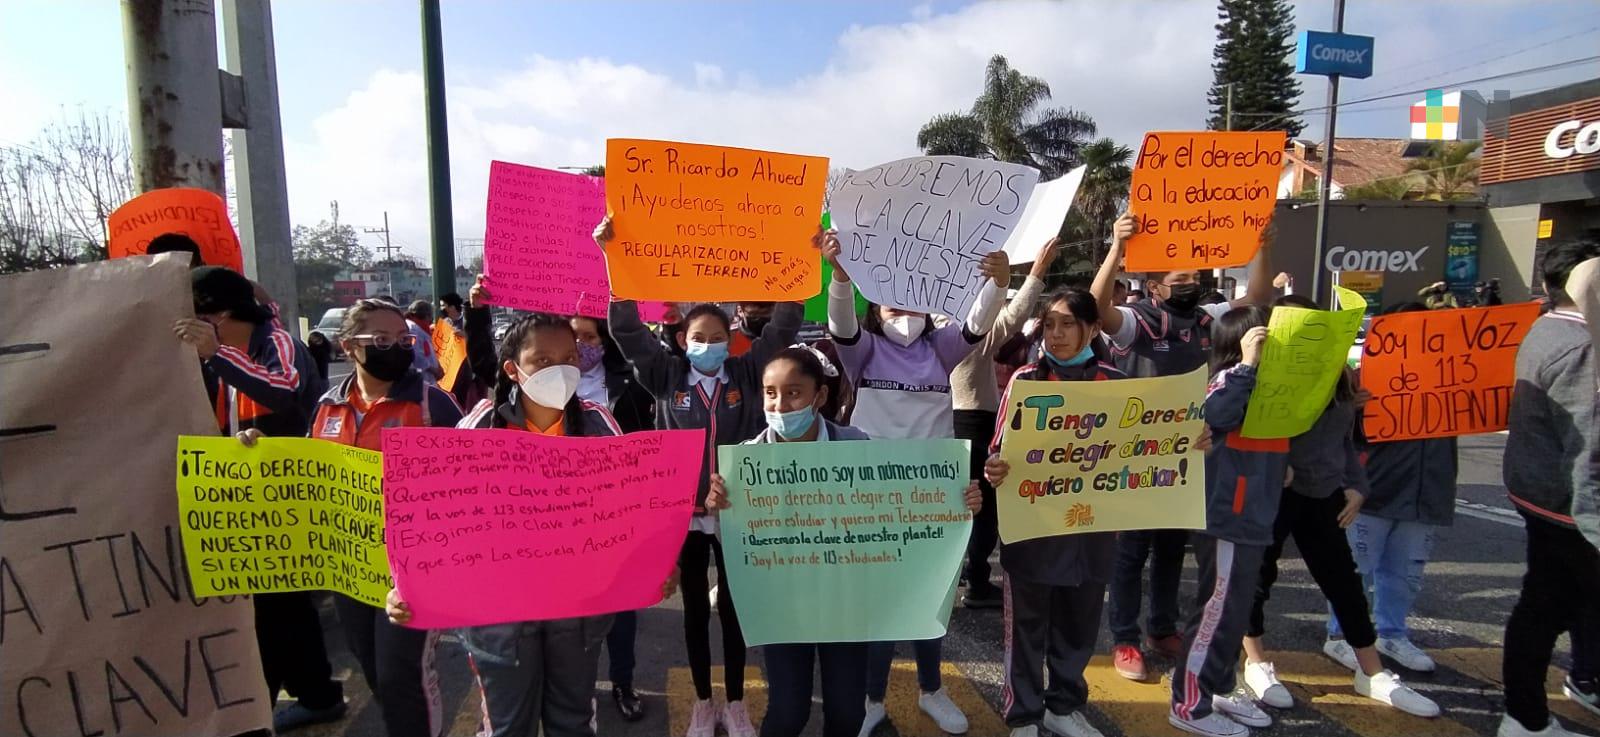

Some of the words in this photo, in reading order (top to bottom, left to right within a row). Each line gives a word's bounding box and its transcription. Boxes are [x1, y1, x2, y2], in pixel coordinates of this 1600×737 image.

[1311, 43, 1368, 64] Comex
[1175, 138, 1193, 168] el
[1201, 138, 1282, 168] derecho
[1544, 120, 1600, 159] Co
[624, 147, 653, 174] Sr.
[665, 148, 739, 178] Ricardo
[752, 157, 807, 186] Ahued
[620, 183, 724, 217] ¡Ayudenos
[738, 193, 782, 215] ahora
[794, 204, 805, 217] a
[1137, 183, 1152, 202] a
[1163, 178, 1177, 204] la
[1185, 178, 1269, 204] educación
[114, 206, 221, 238] ESTUDIANDO
[676, 215, 765, 241] nosotros!
[855, 194, 892, 231] LA
[901, 202, 1006, 257] CLAVE
[1169, 210, 1235, 232] nuestros
[621, 241, 749, 261] REGULARIZACION
[762, 251, 784, 265] DE
[850, 232, 878, 264] DE
[885, 237, 985, 296] NUESTR
[1166, 243, 1177, 258] e
[1191, 239, 1230, 263] hijas!
[1325, 246, 1429, 272] Comex
[656, 263, 680, 277] EL
[693, 263, 759, 278] TERRENO
[1365, 318, 1407, 359] Soy
[1422, 319, 1445, 353] la
[1389, 363, 1419, 391] de
[1434, 354, 1478, 389] 113
[1010, 395, 1107, 439] ¡Tengo
[341, 448, 379, 464] ARTICULO
[386, 453, 437, 469] ¡Tengo
[446, 451, 494, 464] derecho
[416, 435, 474, 448] existo
[482, 439, 505, 447] no
[543, 447, 560, 457] un
[1026, 449, 1044, 465] a
[1049, 439, 1116, 472] elegir
[1119, 433, 1190, 459] donde
[181, 449, 252, 480] ¡TENGO
[260, 459, 337, 481] DERECHO
[340, 467, 349, 486] A
[351, 469, 384, 496] ELEGI
[453, 467, 462, 477] y
[514, 464, 535, 475] mi
[739, 456, 762, 486] ¡Sí
[766, 459, 807, 485] existo
[811, 466, 828, 483] no
[832, 466, 854, 488] soy
[859, 466, 876, 481] un
[877, 460, 928, 481] número
[930, 460, 960, 480] más!
[1018, 475, 1084, 504] quiero
[1092, 458, 1188, 491] estudiar!
[194, 485, 257, 502] DONDE
[263, 485, 326, 502] QUIERO
[329, 486, 382, 517] ESTUDIA
[386, 486, 478, 505] ¡Queremos
[486, 483, 501, 495] la
[554, 485, 571, 496] de
[426, 508, 441, 521] la
[472, 505, 486, 515] de
[494, 504, 515, 515] 113
[519, 496, 594, 516] estudiantes!
[744, 488, 779, 514] Tengo
[785, 488, 833, 506] derecho
[837, 493, 847, 505] a
[850, 488, 884, 510] elegir
[888, 489, 903, 505] en
[187, 508, 300, 530] QUEREMOS
[310, 509, 329, 526] LA
[333, 512, 377, 542] CLAVE
[392, 520, 493, 549] ¡Exigimos
[501, 519, 517, 529] la
[572, 517, 585, 527] de
[747, 518, 781, 534] quiero
[785, 511, 826, 528] estudiar
[831, 516, 838, 529] y
[841, 515, 875, 532] quiero
[879, 512, 893, 523] mi
[814, 531, 841, 544] clave
[843, 530, 856, 543] de
[857, 526, 899, 543] nuestro
[903, 524, 944, 545] plantel!
[200, 534, 292, 553] NUESTRO
[308, 531, 372, 566] PLANTEL
[417, 557, 446, 575] que
[491, 547, 512, 562] La
[517, 545, 576, 559] escuela
[582, 527, 635, 554] Anexa!
[773, 550, 784, 565] la
[810, 551, 820, 564] de
[823, 549, 837, 564] 113
[838, 548, 902, 564] estudiantes!
[201, 558, 224, 572] SI
[230, 554, 338, 571] EXISTIMOS
[341, 559, 358, 579] NO
[359, 567, 395, 590] SOMO
[211, 577, 240, 592] UN
[247, 571, 325, 590] NUMERO
[17, 628, 255, 737] CLAVE
